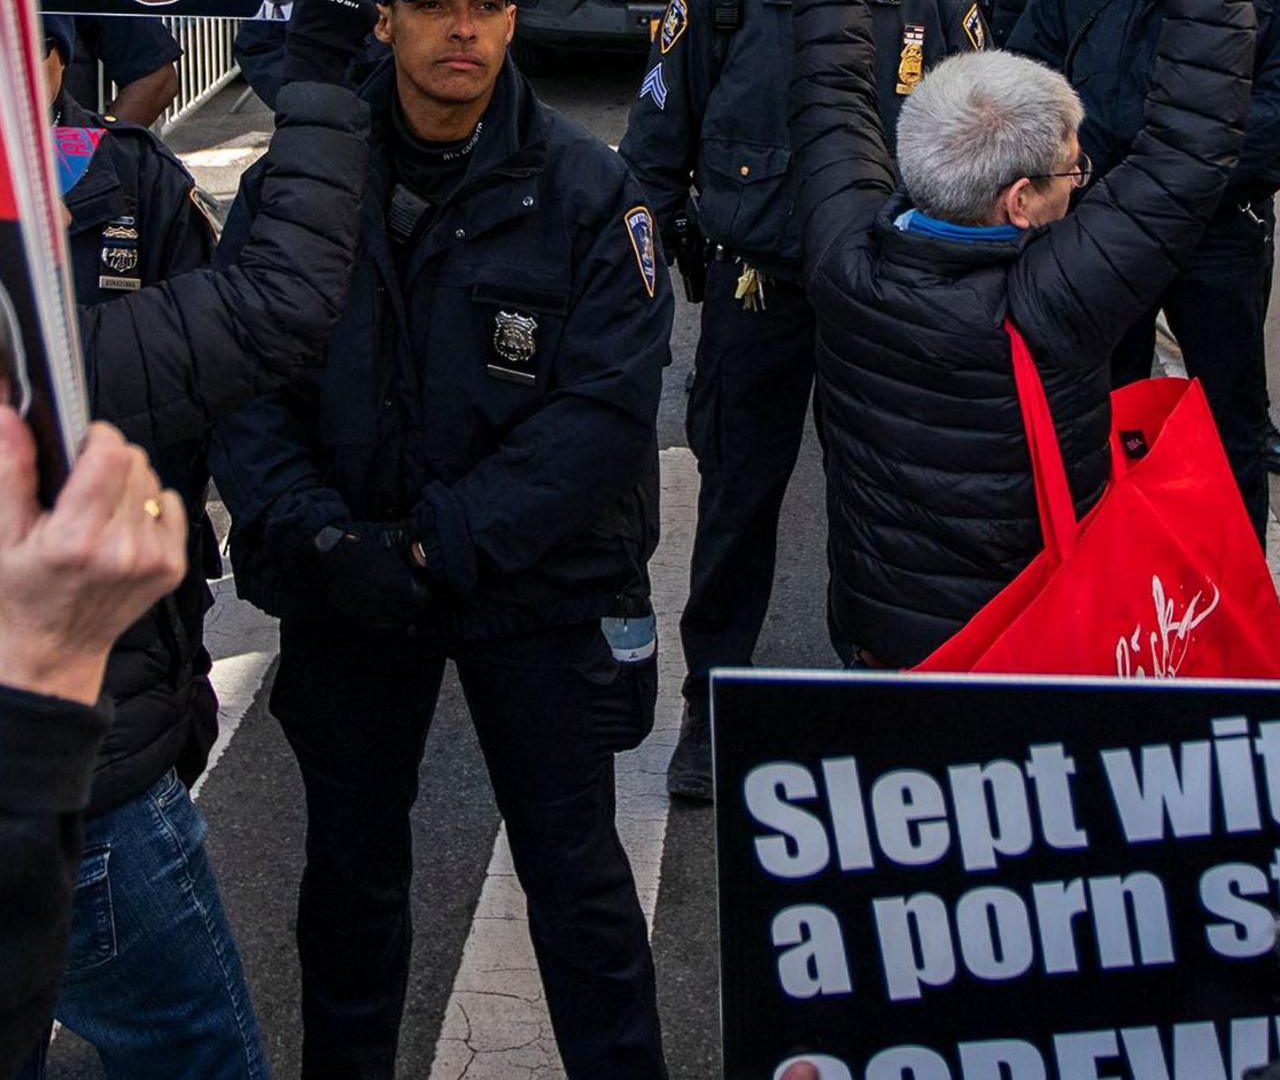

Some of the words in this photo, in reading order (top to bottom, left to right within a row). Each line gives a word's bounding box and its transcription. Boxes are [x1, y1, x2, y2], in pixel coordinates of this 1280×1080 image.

[744, 742, 1088, 879] Slept
[771, 905, 853, 1000] a
[872, 871, 1177, 1003] porn
